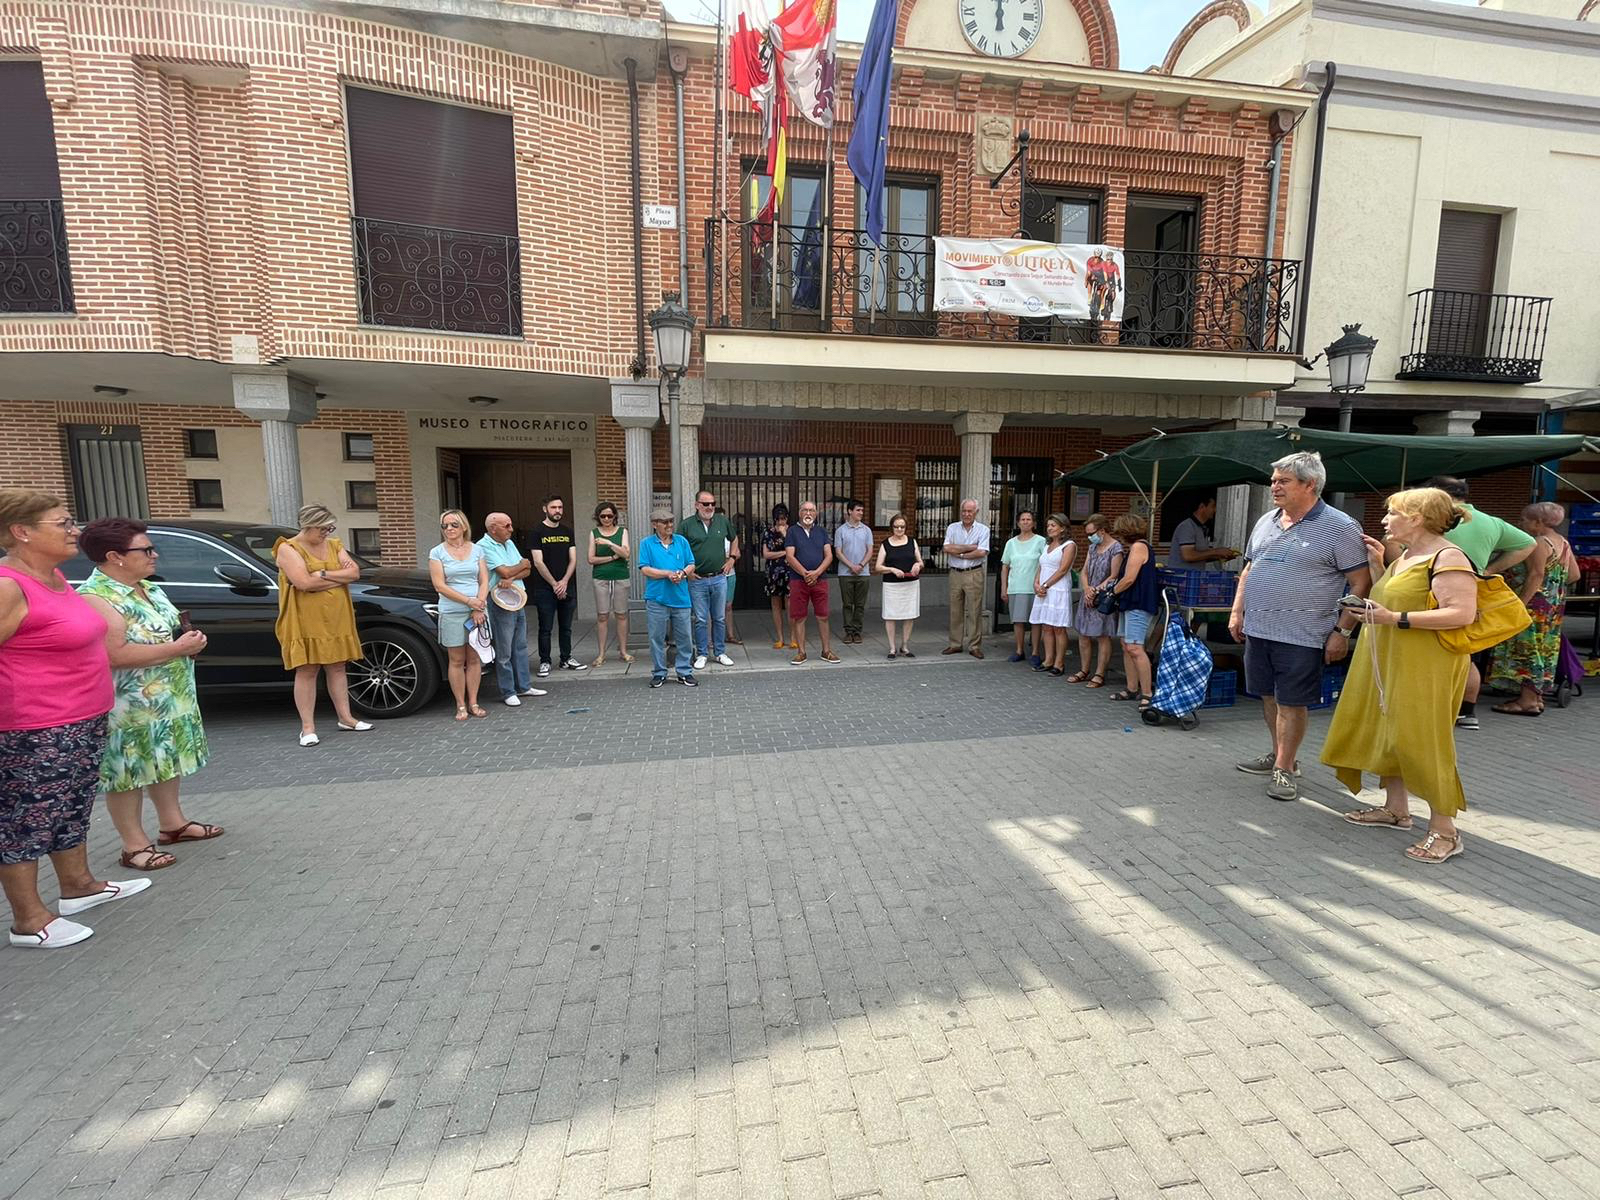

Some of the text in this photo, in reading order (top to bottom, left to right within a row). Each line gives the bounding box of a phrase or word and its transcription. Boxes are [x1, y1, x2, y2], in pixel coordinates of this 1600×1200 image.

[655, 207, 671, 215] Plaza
[649, 217, 671, 227] Mayor
[1014, 253, 1078, 274] ULTREYA
[419, 418, 588, 431] MUSEO ETNOGRAFICO
[100, 425, 113, 435] 21
